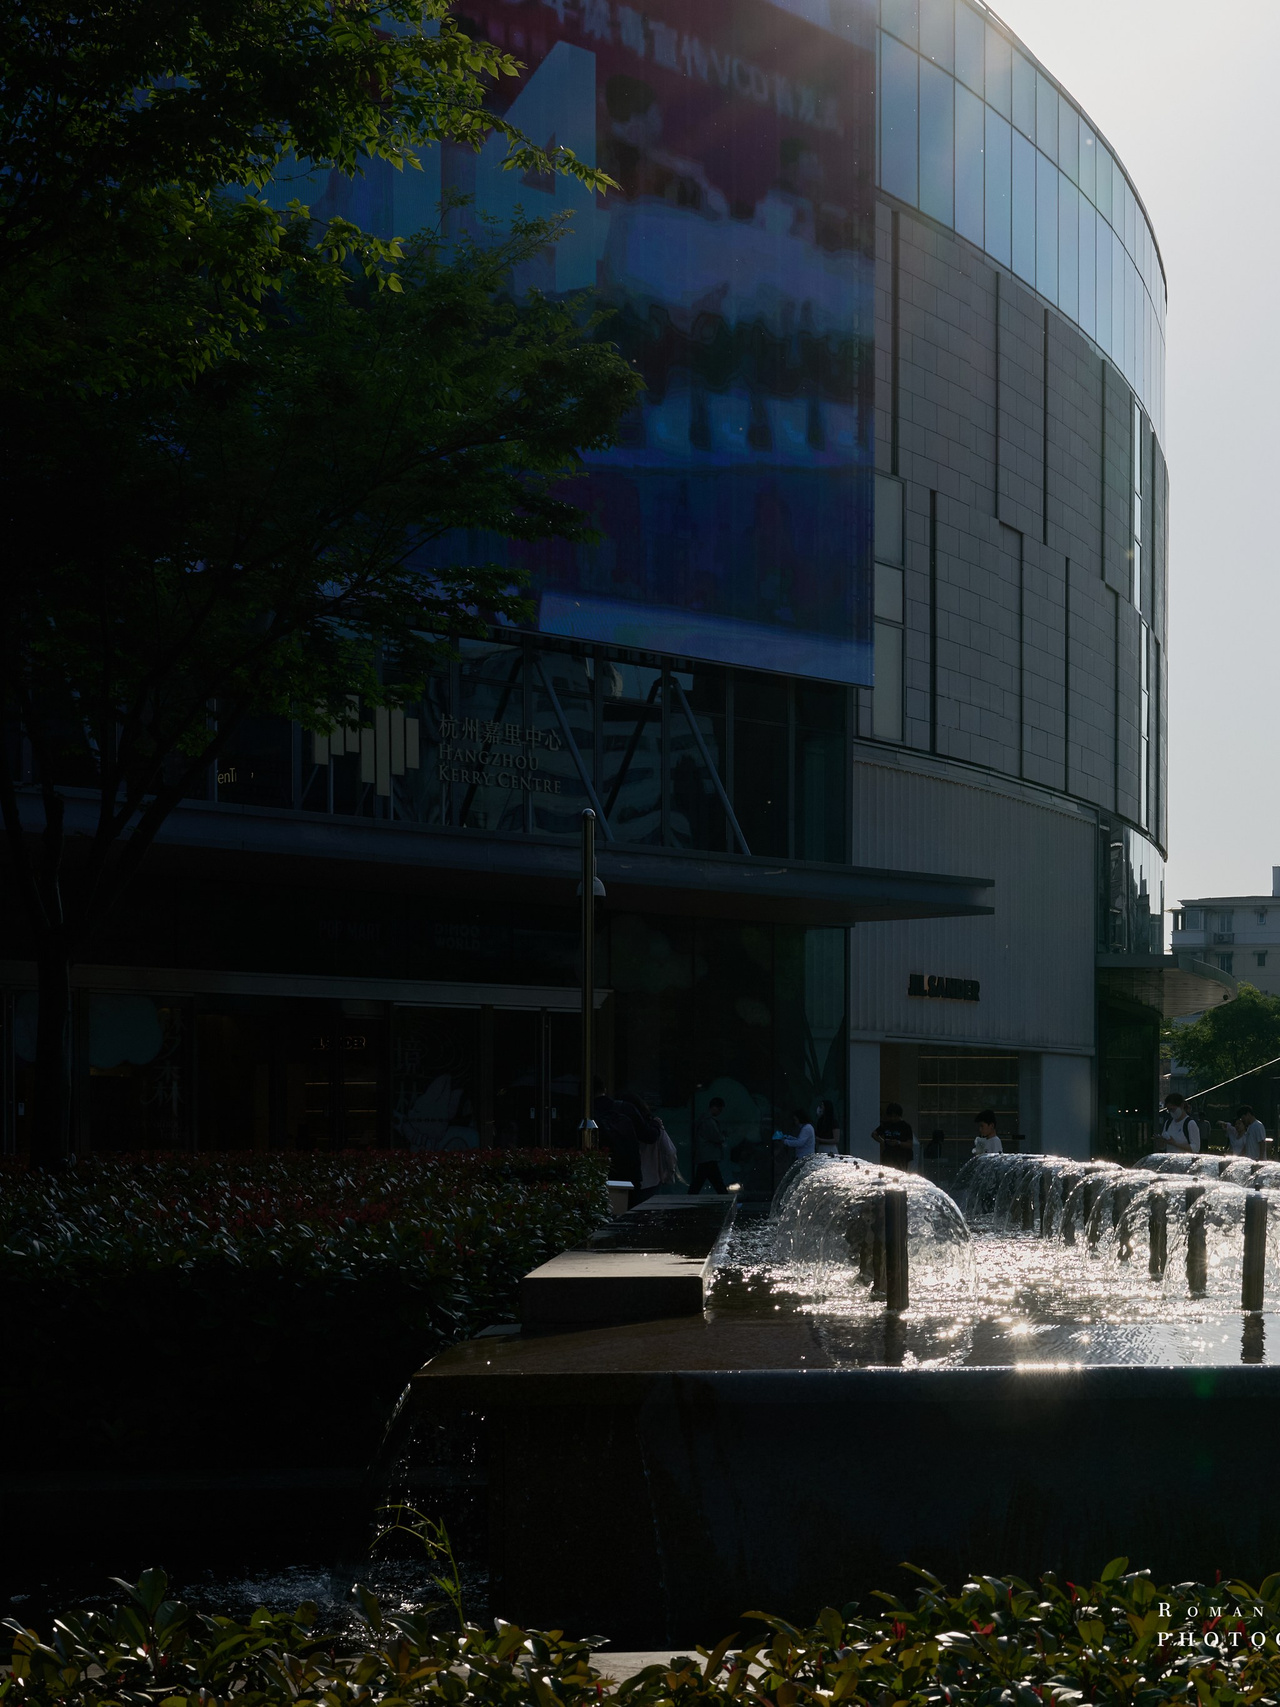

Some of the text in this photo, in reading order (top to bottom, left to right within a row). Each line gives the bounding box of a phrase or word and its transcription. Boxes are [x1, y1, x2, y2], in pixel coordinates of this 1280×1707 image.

[438, 712, 562, 751] 杭州嘉里中心
[438, 742, 540, 771] HANGZHOU
[438, 764, 562, 795] KERRY CENTRE
[928, 975, 981, 1002] SANDER
